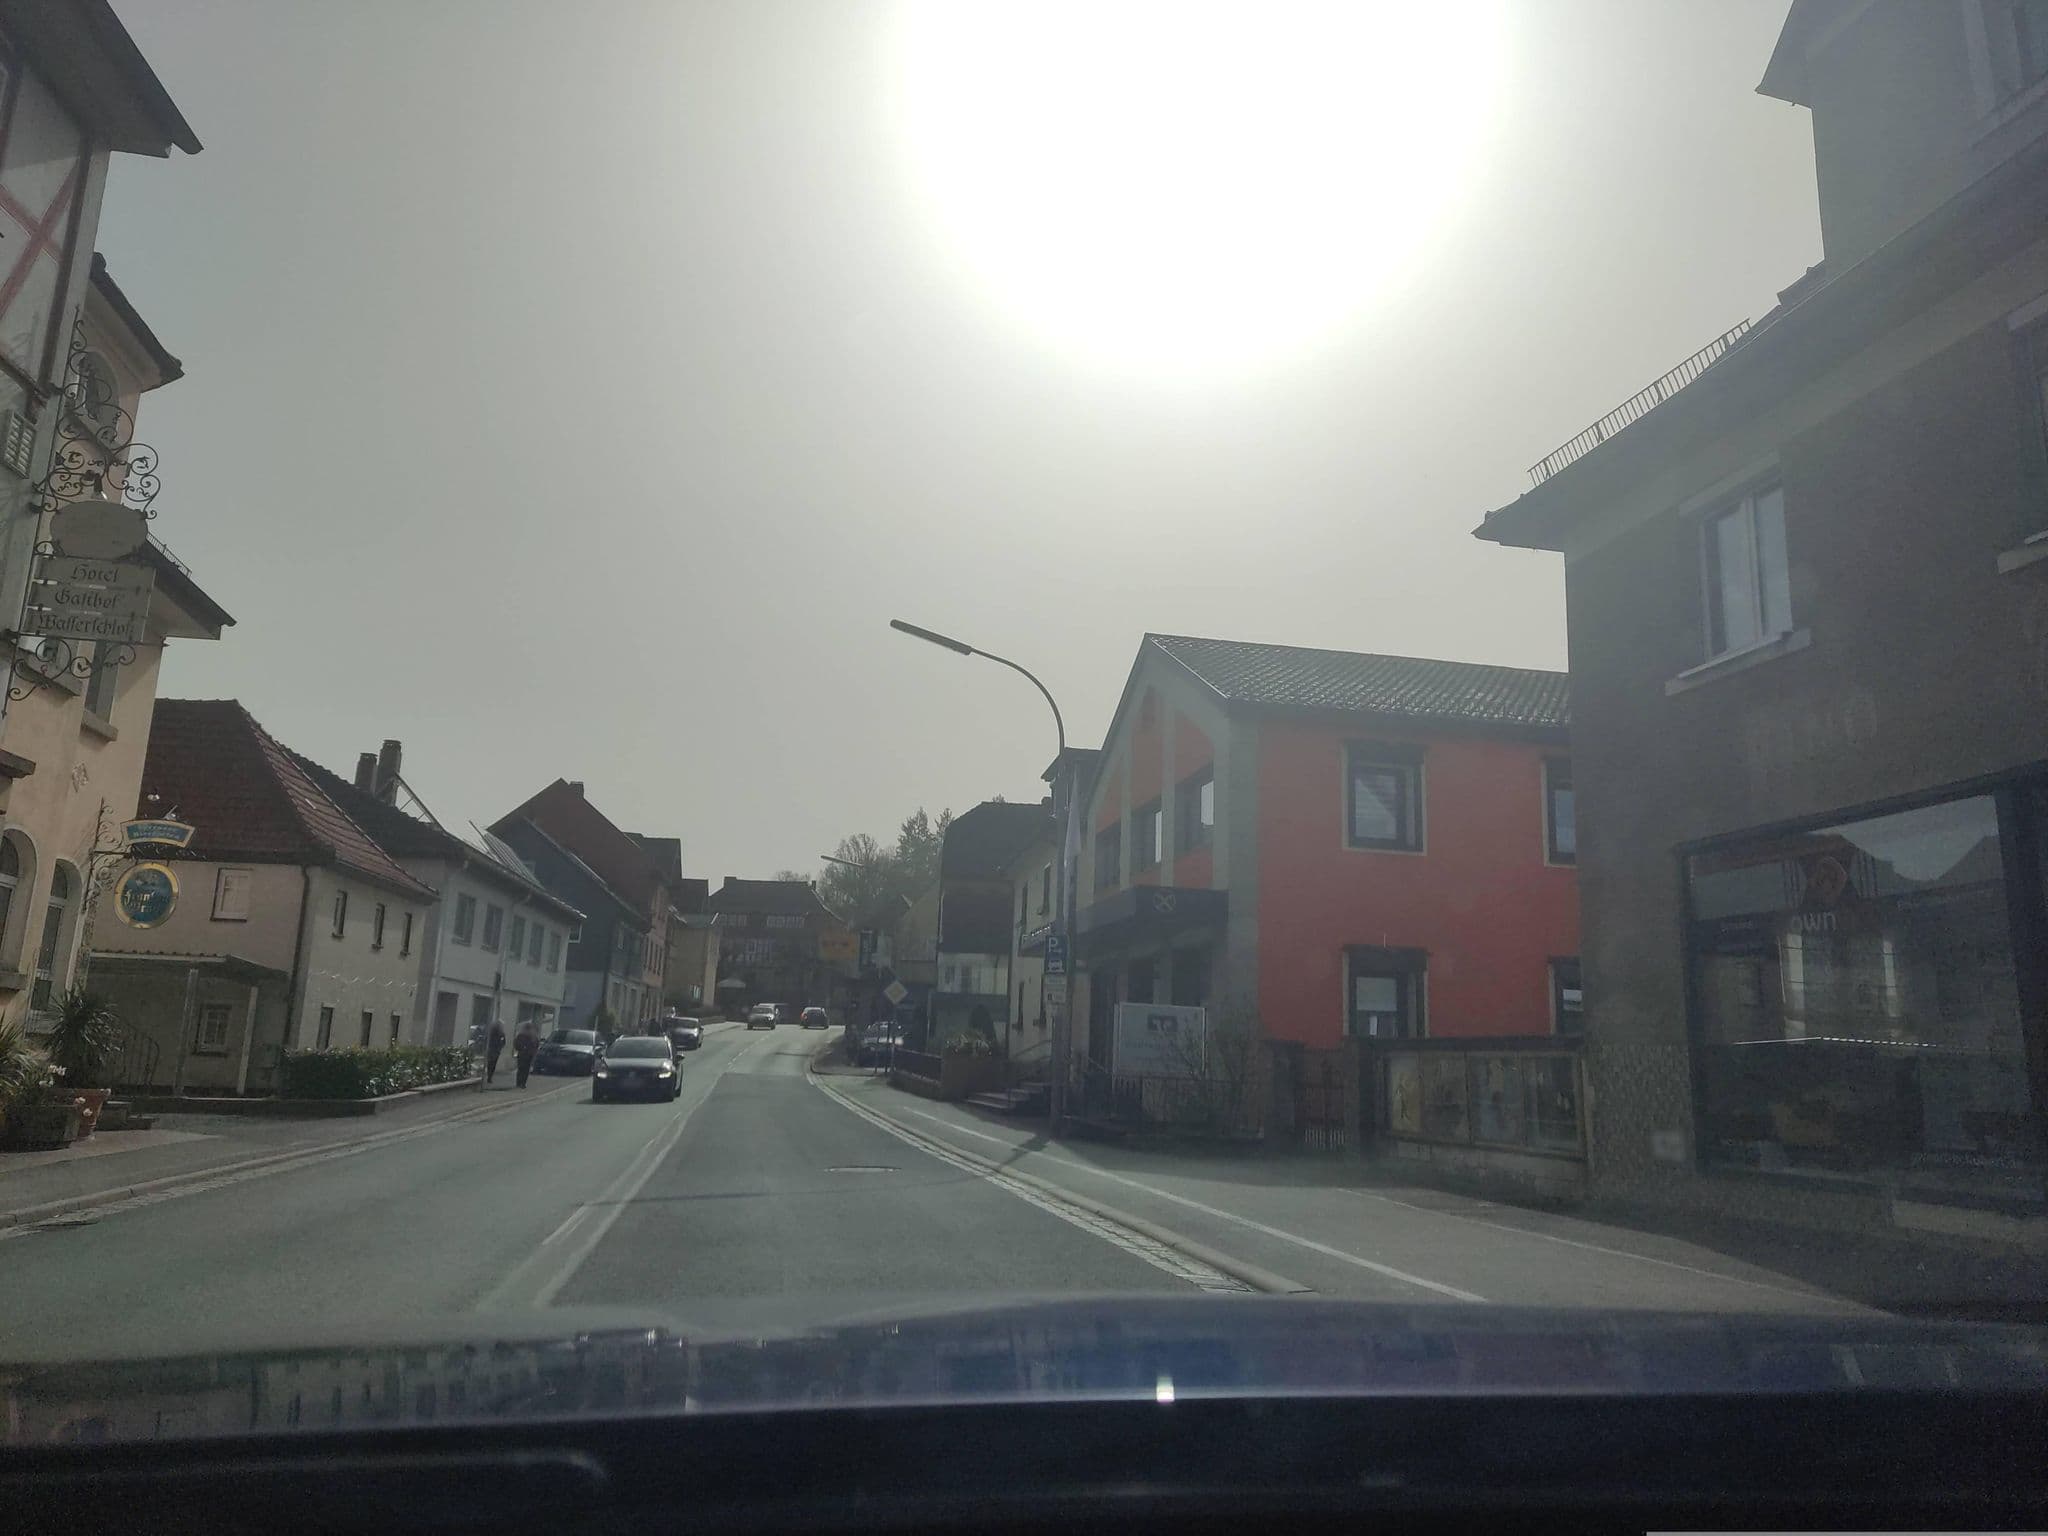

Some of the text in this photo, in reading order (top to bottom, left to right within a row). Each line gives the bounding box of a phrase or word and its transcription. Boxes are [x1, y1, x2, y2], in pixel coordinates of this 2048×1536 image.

[70, 562, 119, 583] Hotel
[54, 587, 120, 609] Gasthof
[1048, 936, 1059, 953] P
